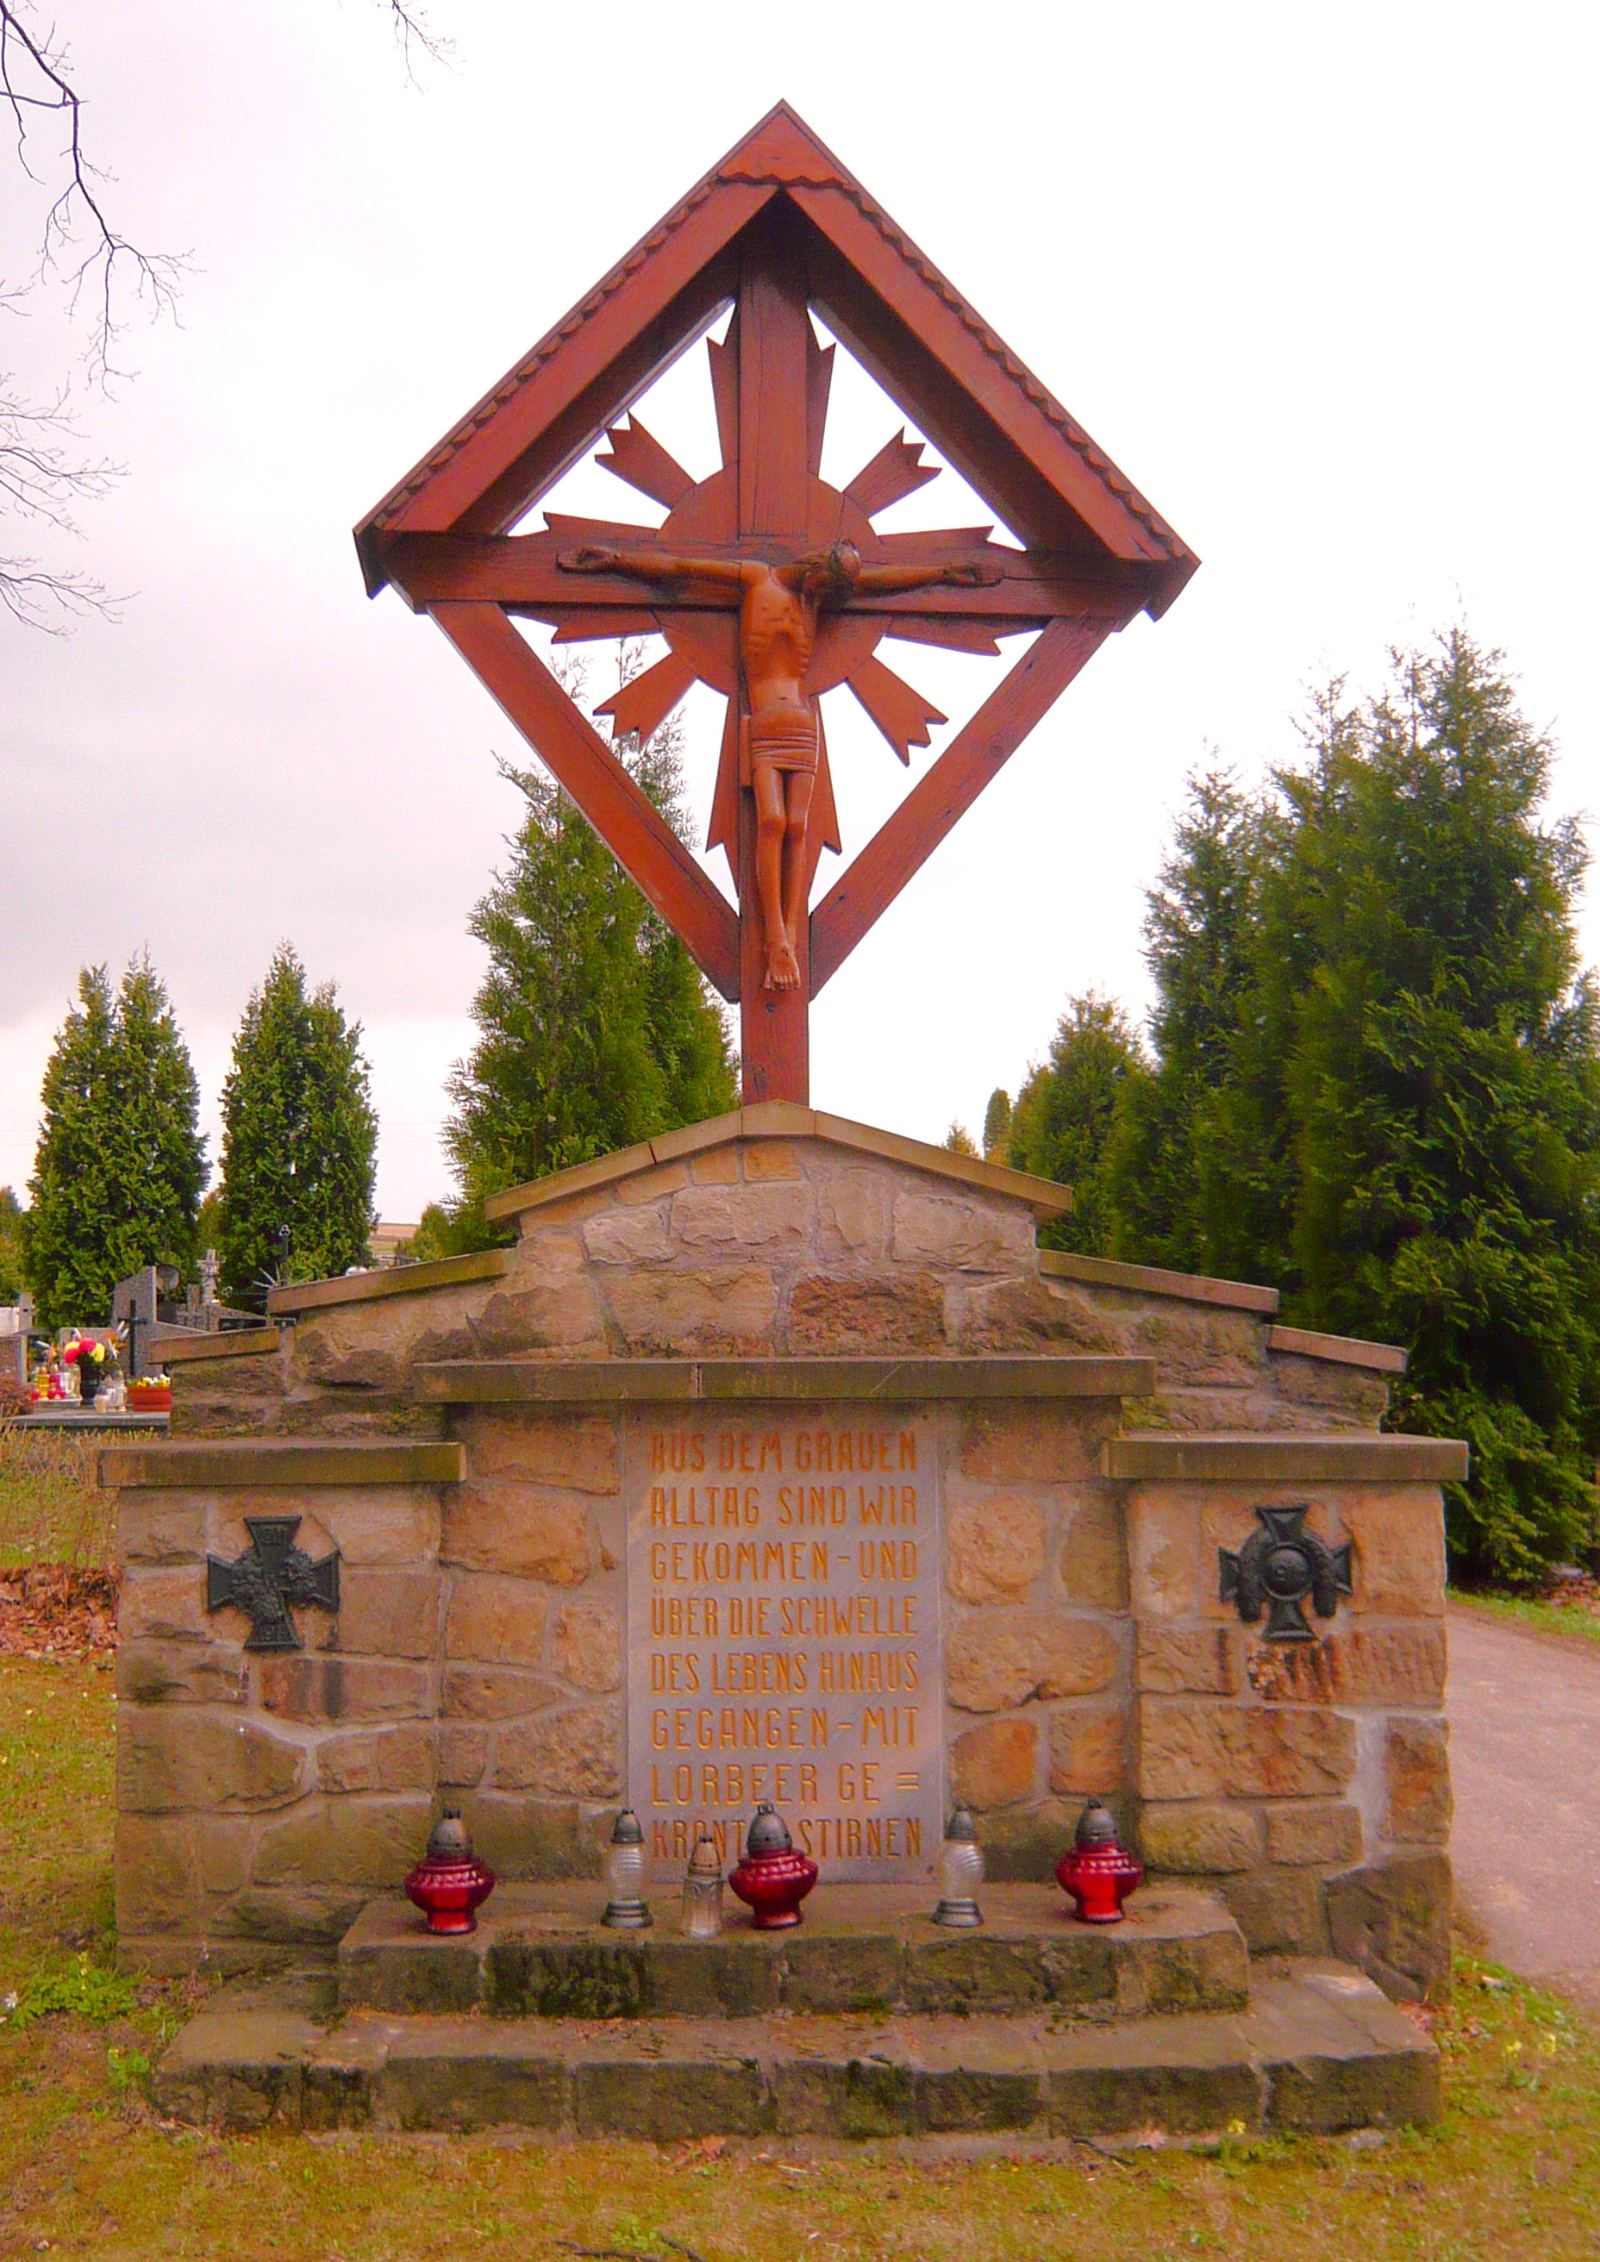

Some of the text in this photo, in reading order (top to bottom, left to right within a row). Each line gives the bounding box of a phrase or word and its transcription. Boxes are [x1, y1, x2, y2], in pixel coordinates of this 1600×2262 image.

[652, 1430, 918, 1474] AUS DEM GRAUEN
[651, 1485, 918, 1529] ALLTAG SIND WIR
[651, 1541, 830, 1584] GEKOMMEN
[858, 1540, 919, 1584] UND
[651, 1588, 918, 1639] ÜBER DIE SCHWELLE
[651, 1651, 919, 1695] DES LEBENS HINAUS
[652, 1707, 830, 1751] GEGANGEN
[860, 1706, 920, 1749] MIT
[651, 1763, 818, 1807] LORBEER
[838, 1762, 881, 1806] GE
[799, 1817, 922, 1861] STIRNEN
